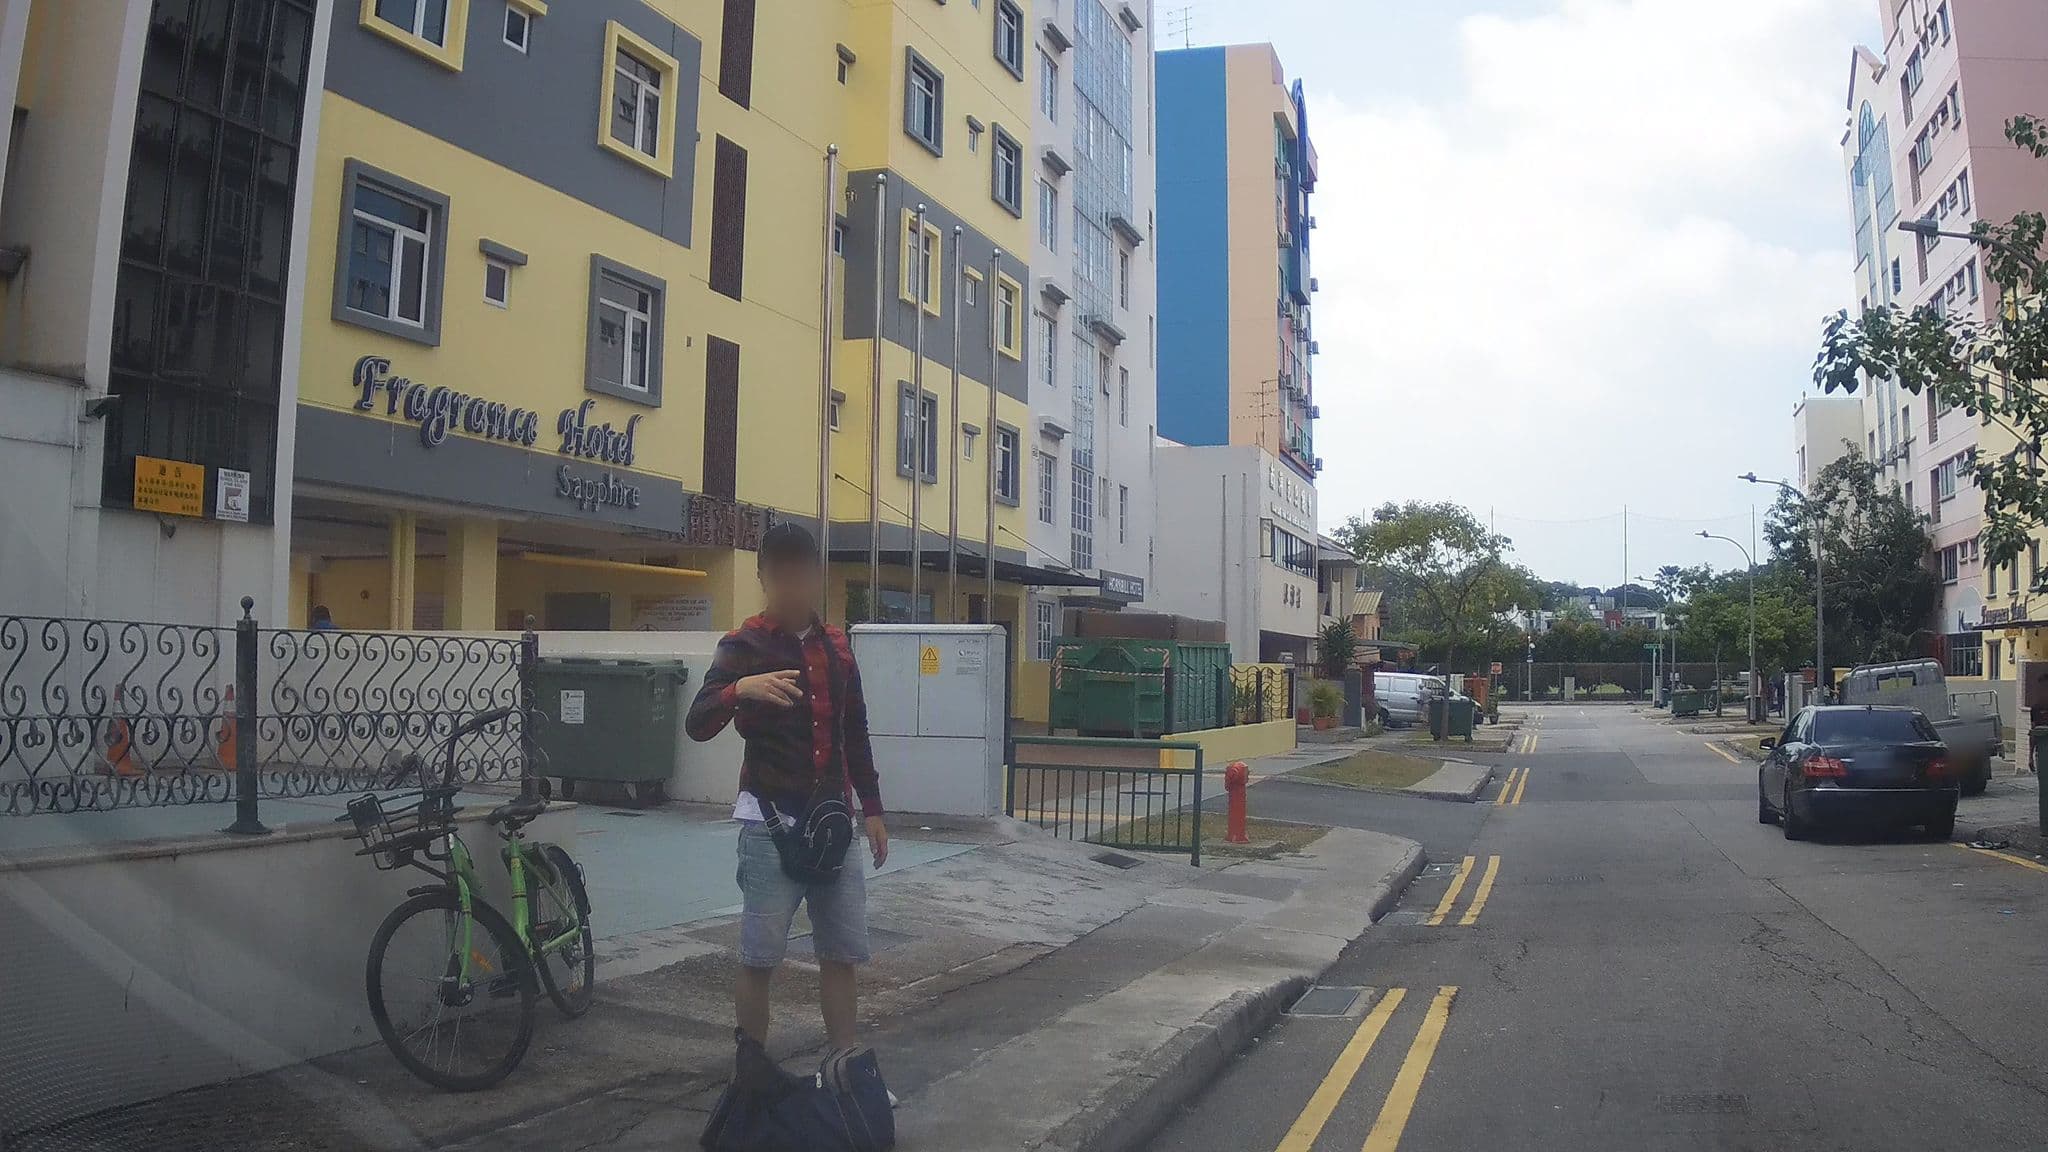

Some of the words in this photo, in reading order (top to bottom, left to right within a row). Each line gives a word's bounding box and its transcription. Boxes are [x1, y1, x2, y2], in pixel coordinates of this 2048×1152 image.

[353, 355, 538, 449] Fragrance
[557, 399, 644, 466] Hotel
[556, 464, 641, 513] Sapphire
